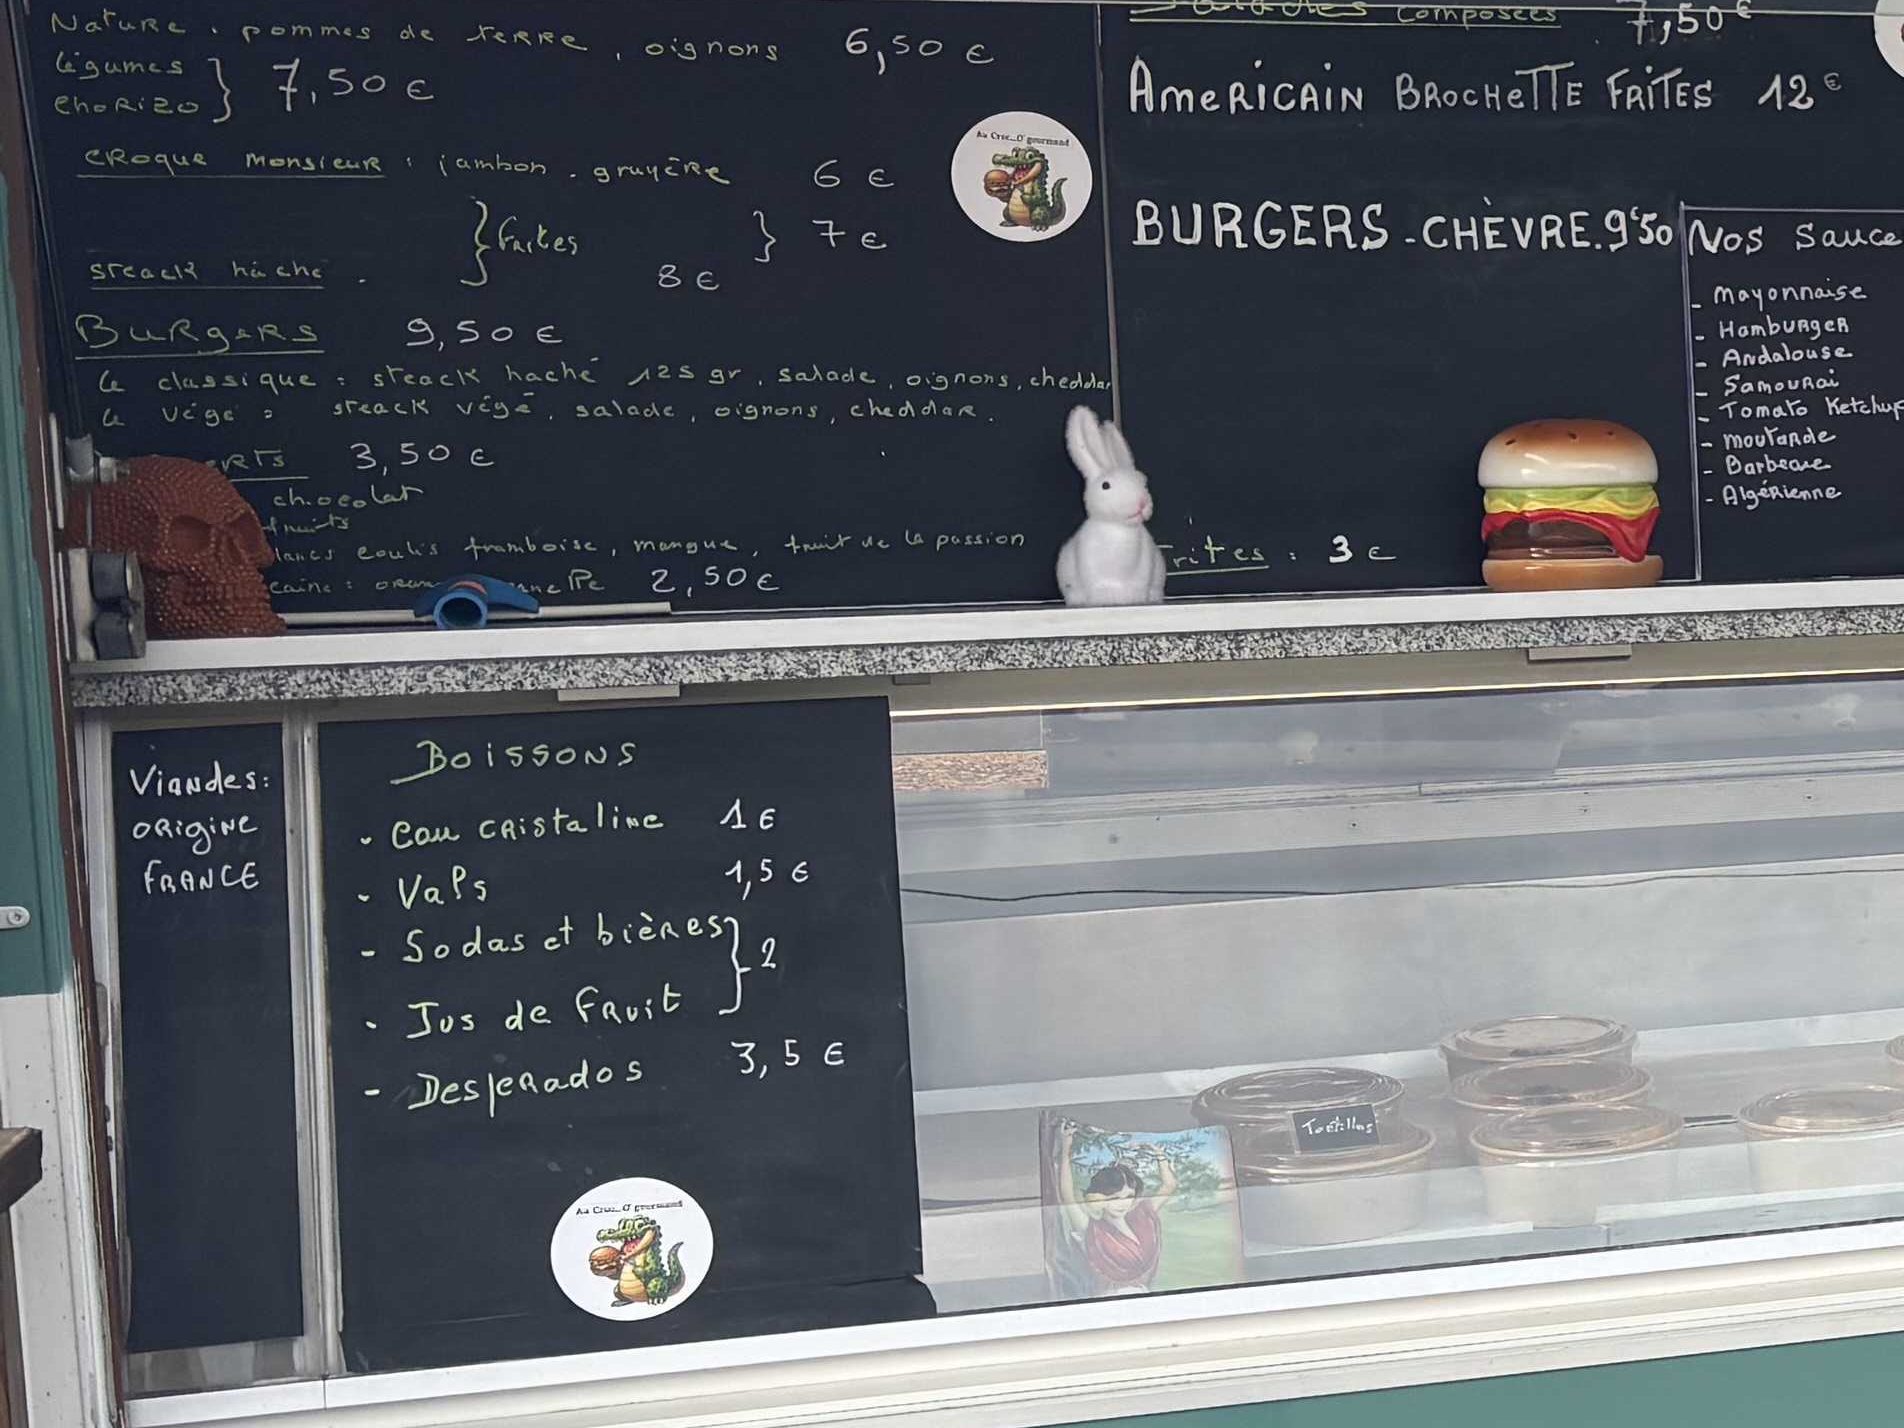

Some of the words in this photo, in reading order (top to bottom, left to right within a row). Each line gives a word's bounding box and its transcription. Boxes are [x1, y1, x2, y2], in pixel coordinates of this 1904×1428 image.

[242, 25, 371, 43] pommes
[398, 24, 434, 42] de
[844, 27, 944, 75] 6,50
[272, 58, 386, 112] 7,50
[813, 159, 842, 188] 6
[811, 219, 846, 249] 7
[1132, 199, 1389, 251] BURGERS
[657, 265, 682, 289] 8
[405, 318, 514, 352] 9,50
[157, 371, 318, 401] classique
[349, 443, 451, 476] 3,50
[1328, 534, 1353, 564] 3
[651, 566, 747, 598] 2,50
[725, 857, 774, 901] 1,5
[543, 915, 573, 953] et
[760, 936, 777, 969] 2
[504, 1000, 552, 1032] de
[731, 1039, 800, 1079] 3,5
